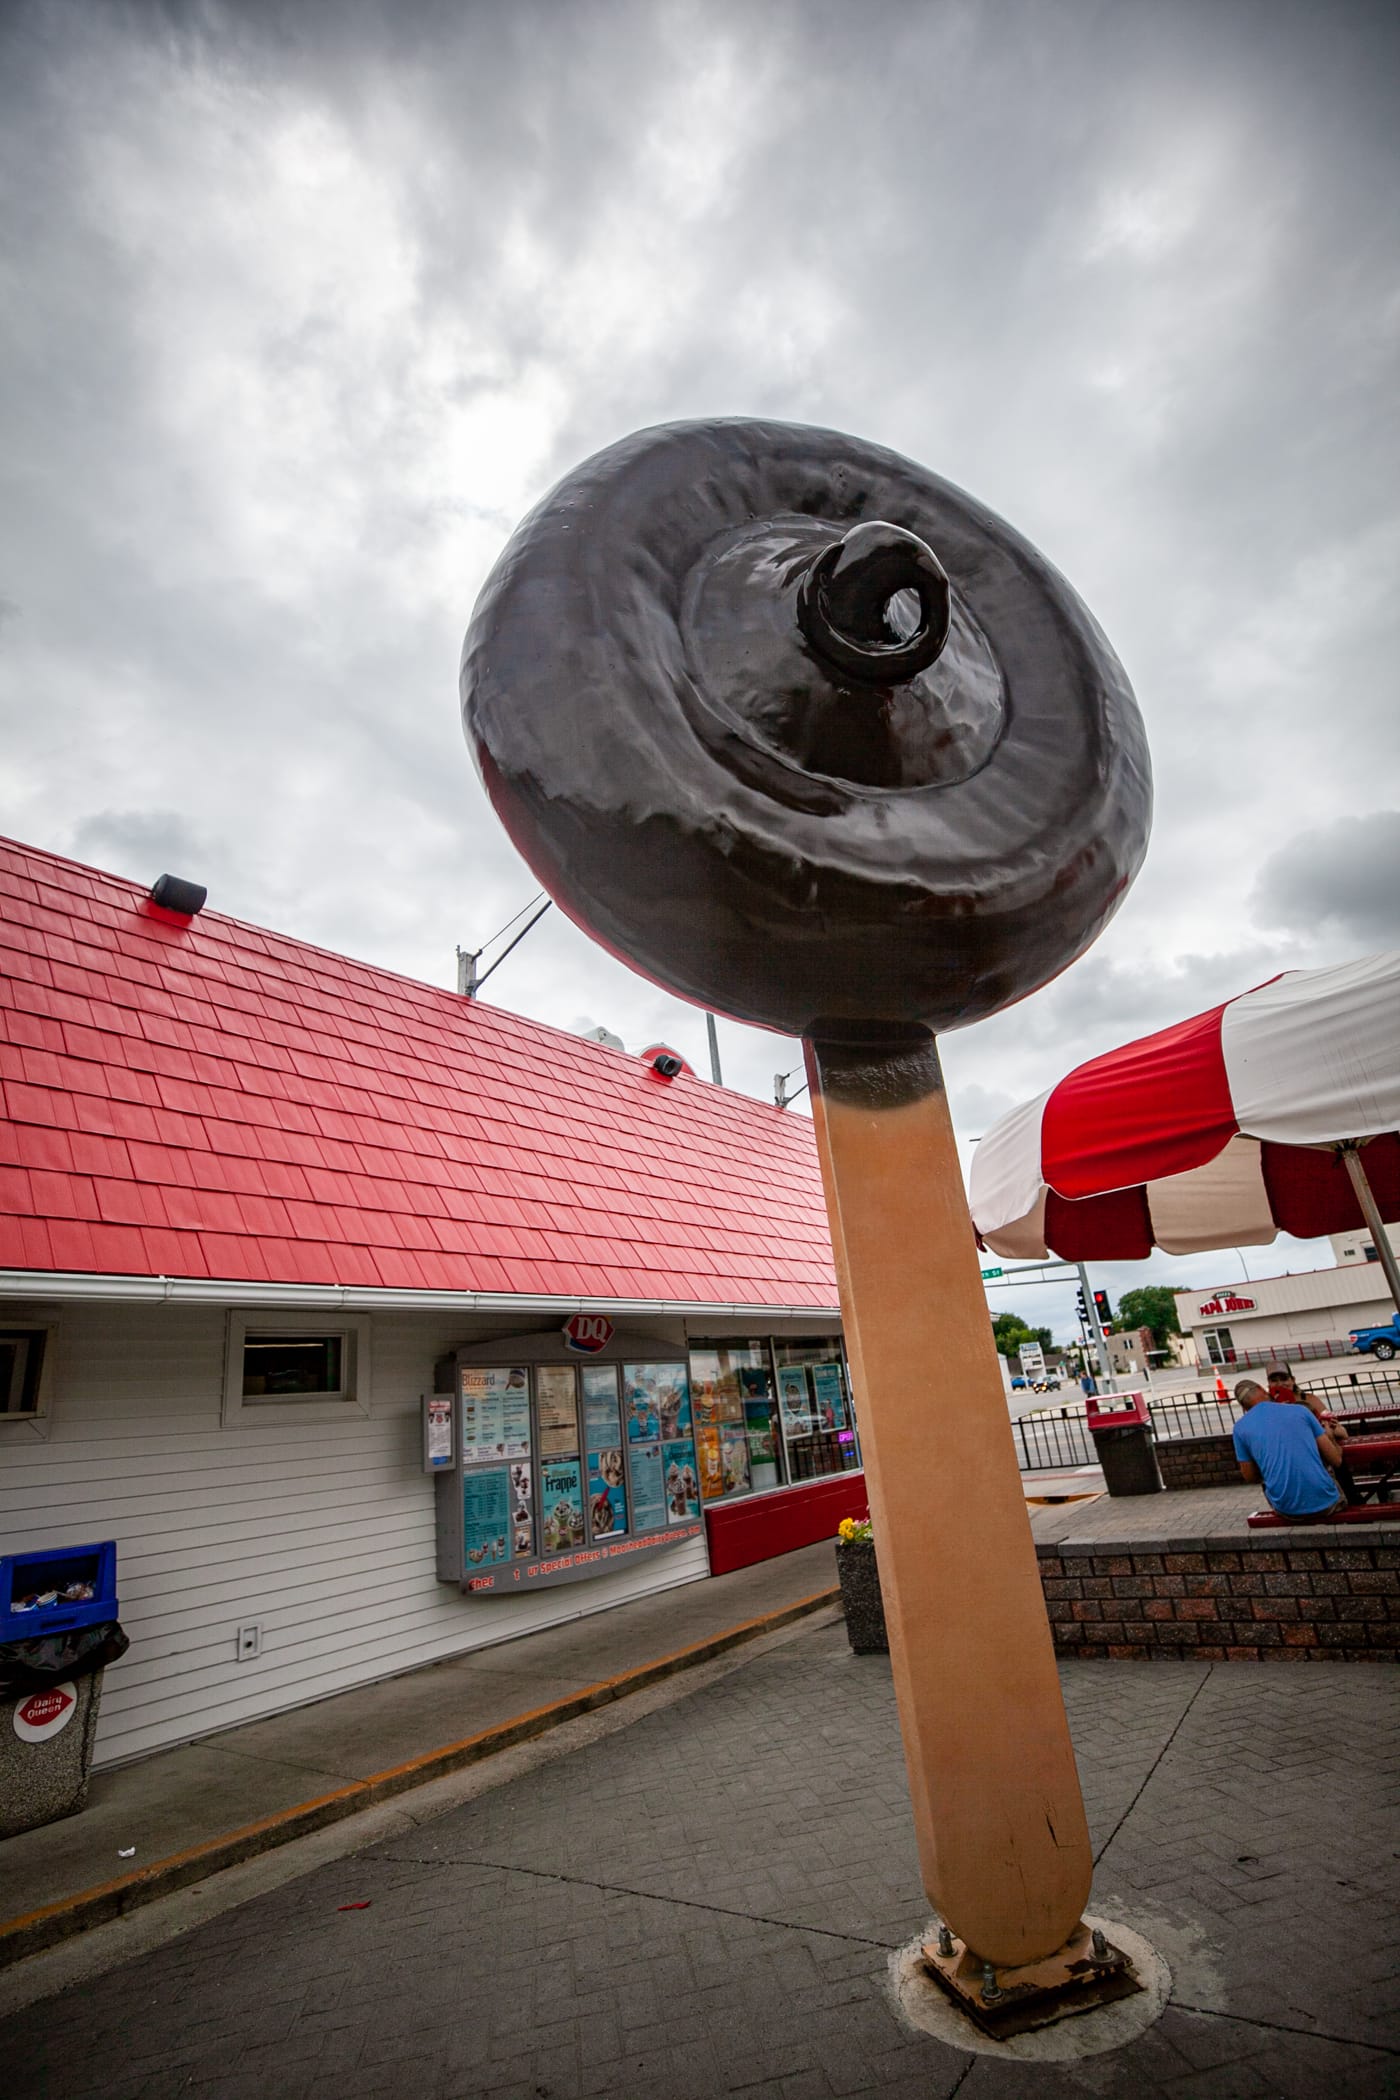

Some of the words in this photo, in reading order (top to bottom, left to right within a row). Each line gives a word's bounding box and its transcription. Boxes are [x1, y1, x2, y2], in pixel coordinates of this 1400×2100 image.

[992, 1269, 1000, 1277] St
[1200, 1298, 1224, 1316] PAPA
[575, 1316, 607, 1343] DQ
[462, 1373, 496, 1387] Blizzard
[540, 1556, 573, 1574] Special
[574, 1550, 600, 1565] Offers
[34, 1696, 62, 1709] Dairy
[27, 1704, 61, 1720] Queen
